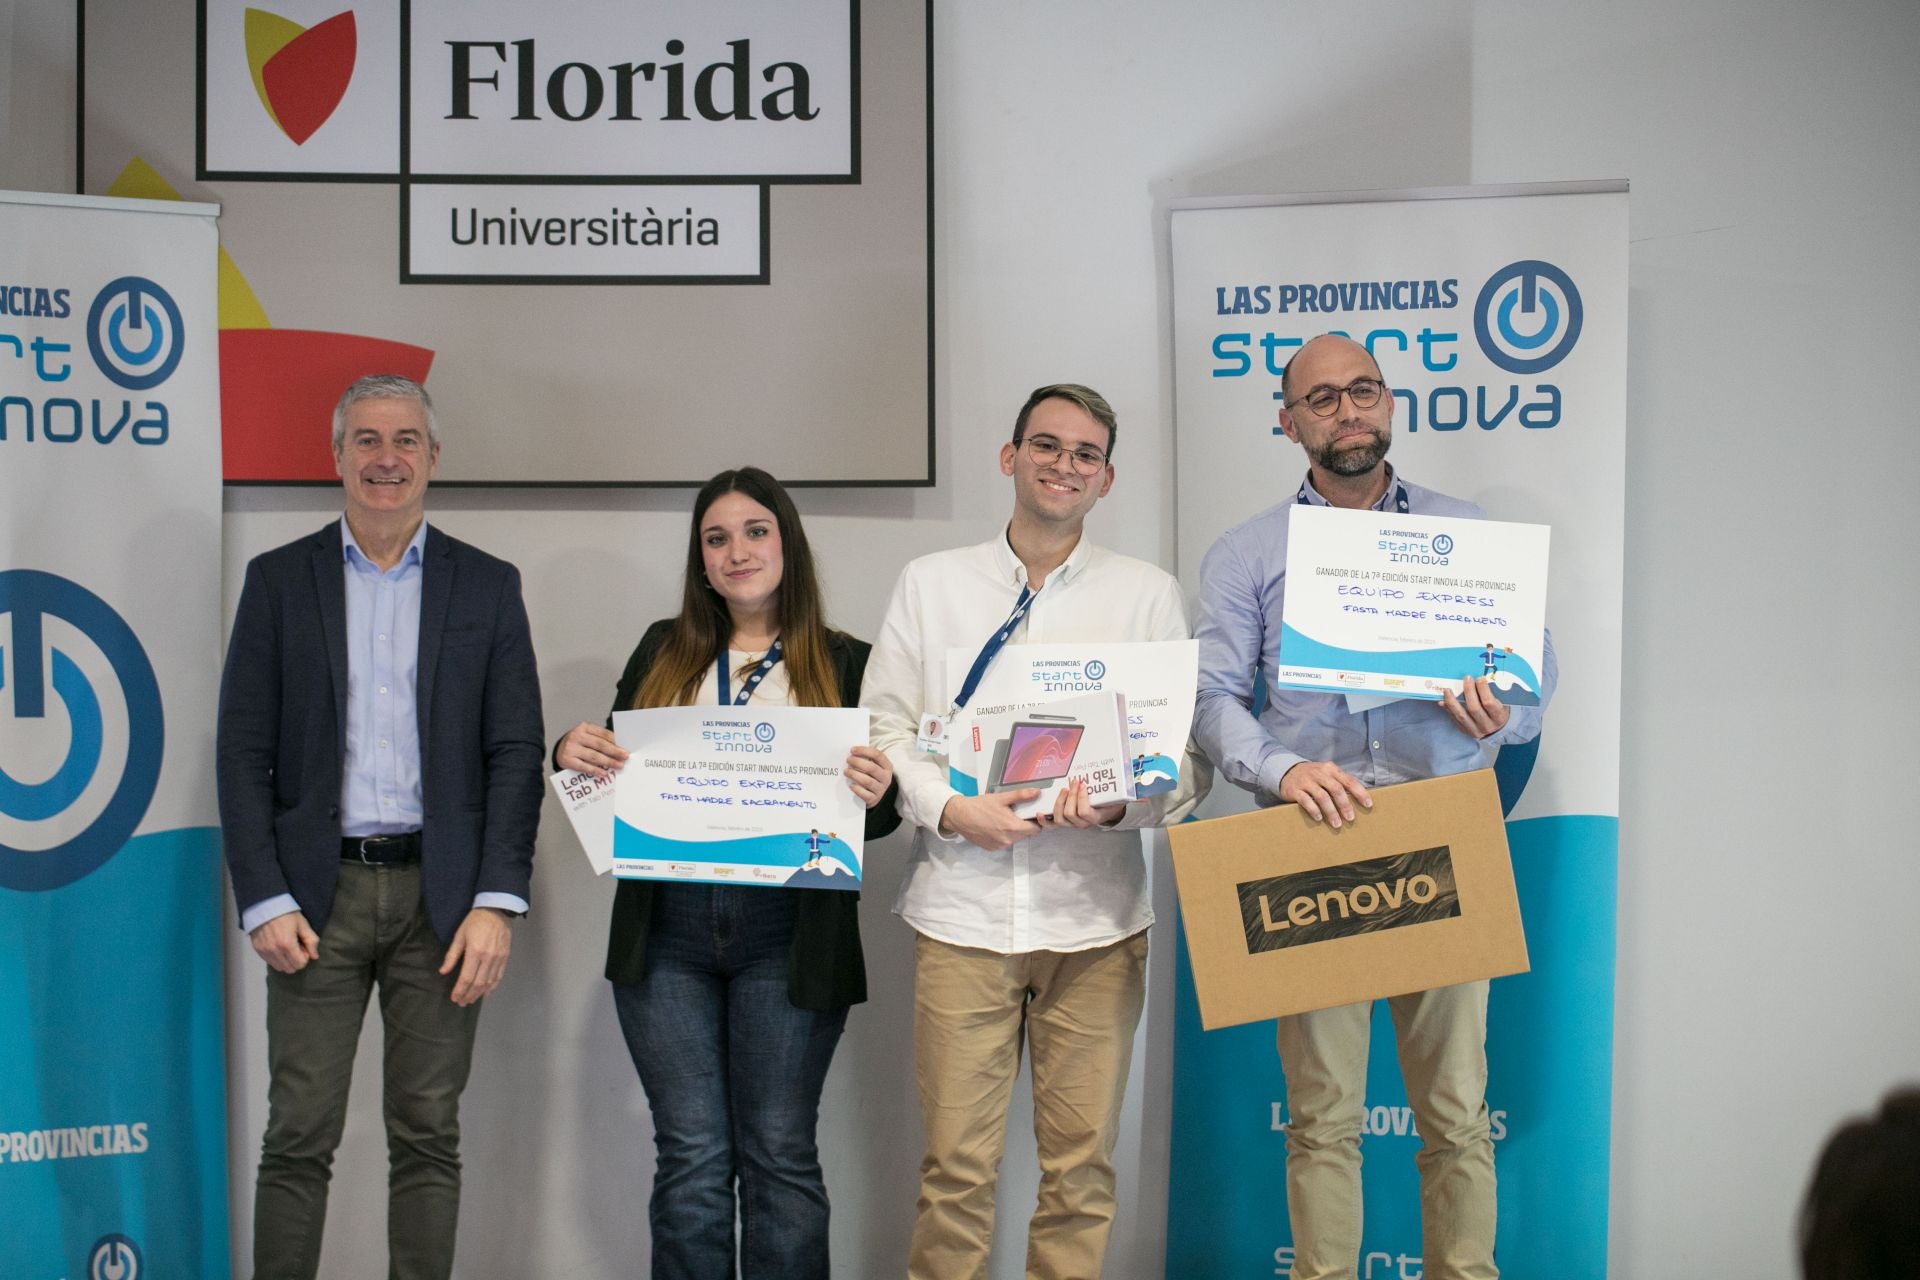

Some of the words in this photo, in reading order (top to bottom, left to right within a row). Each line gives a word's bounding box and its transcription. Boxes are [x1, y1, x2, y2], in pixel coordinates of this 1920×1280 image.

[444, 38, 820, 121] Florida
[451, 206, 719, 246] Universitària
[1216, 286, 1271, 315] LAS
[1279, 279, 1459, 312] PROVINCIAS
[1212, 328, 1459, 378] strt
[1392, 530, 1429, 539] PROVINCIAS
[1378, 540, 1429, 553] start
[1316, 567, 1349, 578] GANADOR
[1350, 569, 1359, 578] DE
[1361, 570, 1370, 580] LA
[1382, 570, 1409, 583] EDICIÓN
[1410, 574, 1432, 585] START
[1433, 576, 1459, 587] INNOVA
[1460, 578, 1474, 588] LAS
[1475, 579, 1516, 591] PROVINCIAS
[1338, 584, 1405, 599] EQUIPO
[1415, 591, 1496, 607] EXPRESS
[1342, 604, 1379, 615] FASTA
[1032, 671, 1082, 681] start
[976, 705, 1007, 716] GANADOR
[1129, 698, 1168, 709] PROVINCIAS
[715, 720, 750, 728] PROVINCIAS
[702, 730, 752, 742] start
[644, 758, 676, 769] GANADOR
[678, 760, 687, 769] DE
[688, 761, 697, 769] LA
[708, 760, 734, 771] EDICIÓN
[735, 763, 757, 773] START
[758, 765, 782, 774] INNOVA
[784, 766, 798, 775] LAS
[799, 766, 839, 776] PROVINCIAS
[1093, 768, 1117, 782] Tab
[565, 784, 593, 802] Tab
[739, 779, 803, 791] EXPRESS
[1258, 873, 1438, 932] Lenovo
